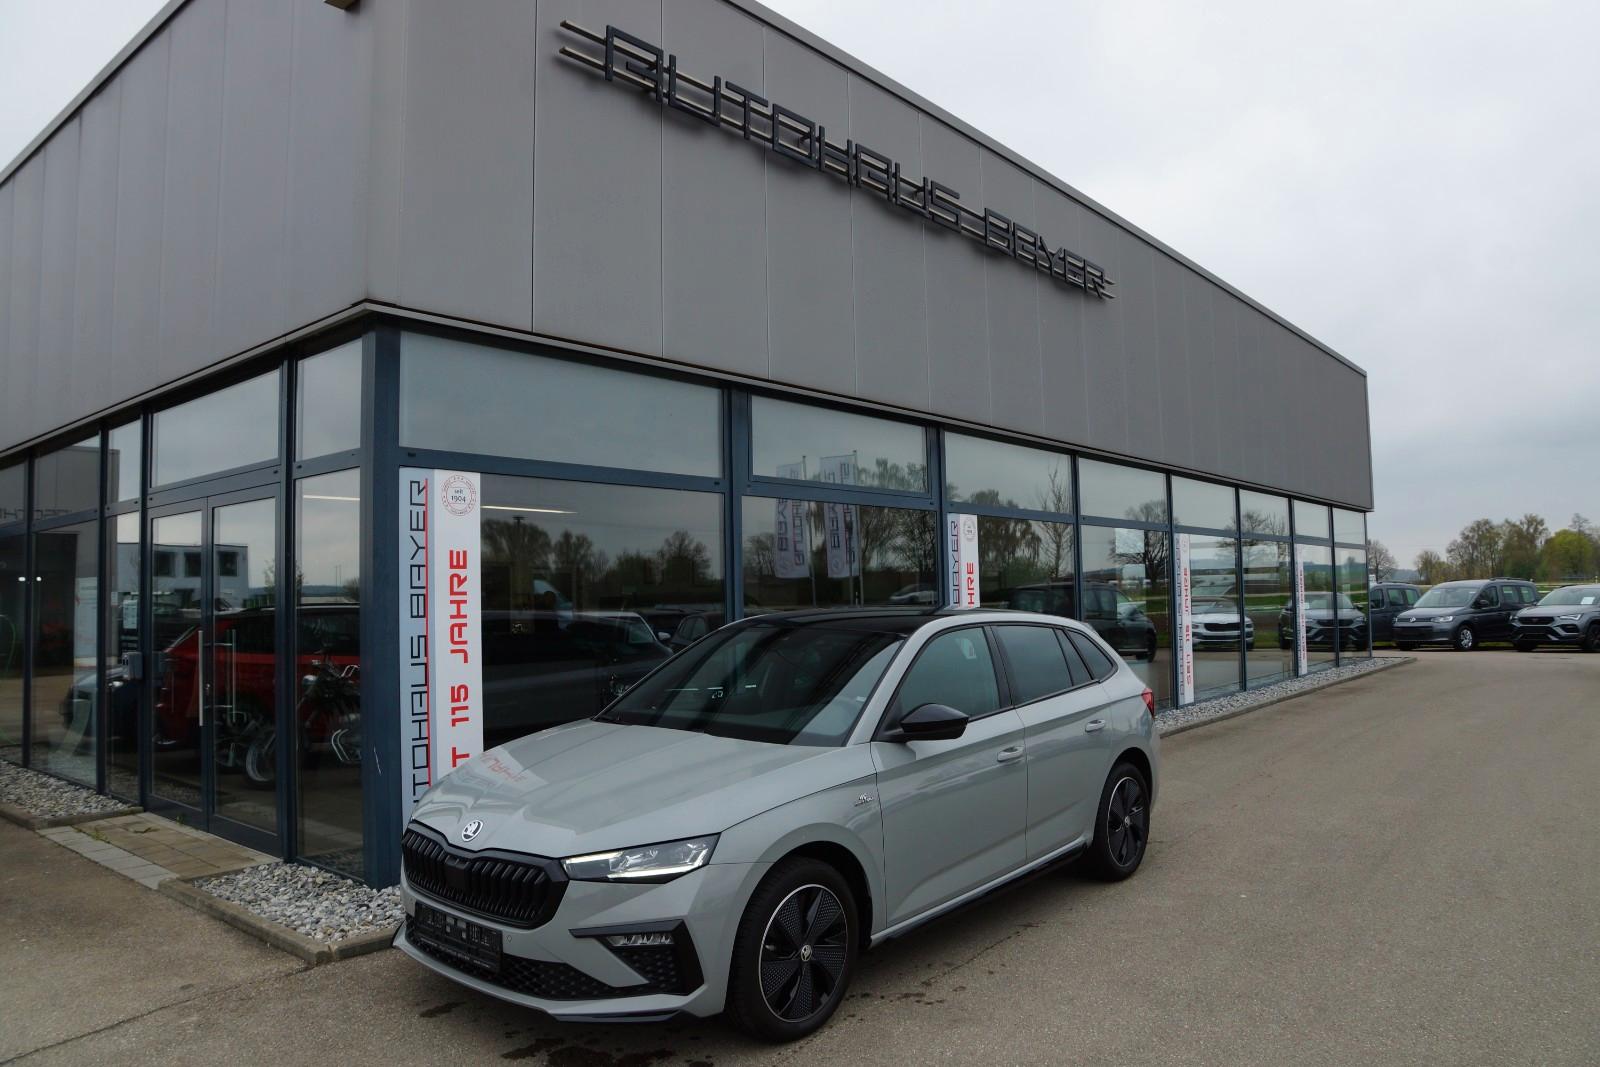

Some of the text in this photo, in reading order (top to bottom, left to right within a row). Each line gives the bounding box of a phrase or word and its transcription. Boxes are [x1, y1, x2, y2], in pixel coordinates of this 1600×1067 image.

[604, 24, 962, 233] AUTOHAUS
[410, 480, 427, 619] BAYER
[451, 495, 466, 503] 1904
[450, 549, 469, 664] JAHRE
[451, 683, 469, 727] 115
